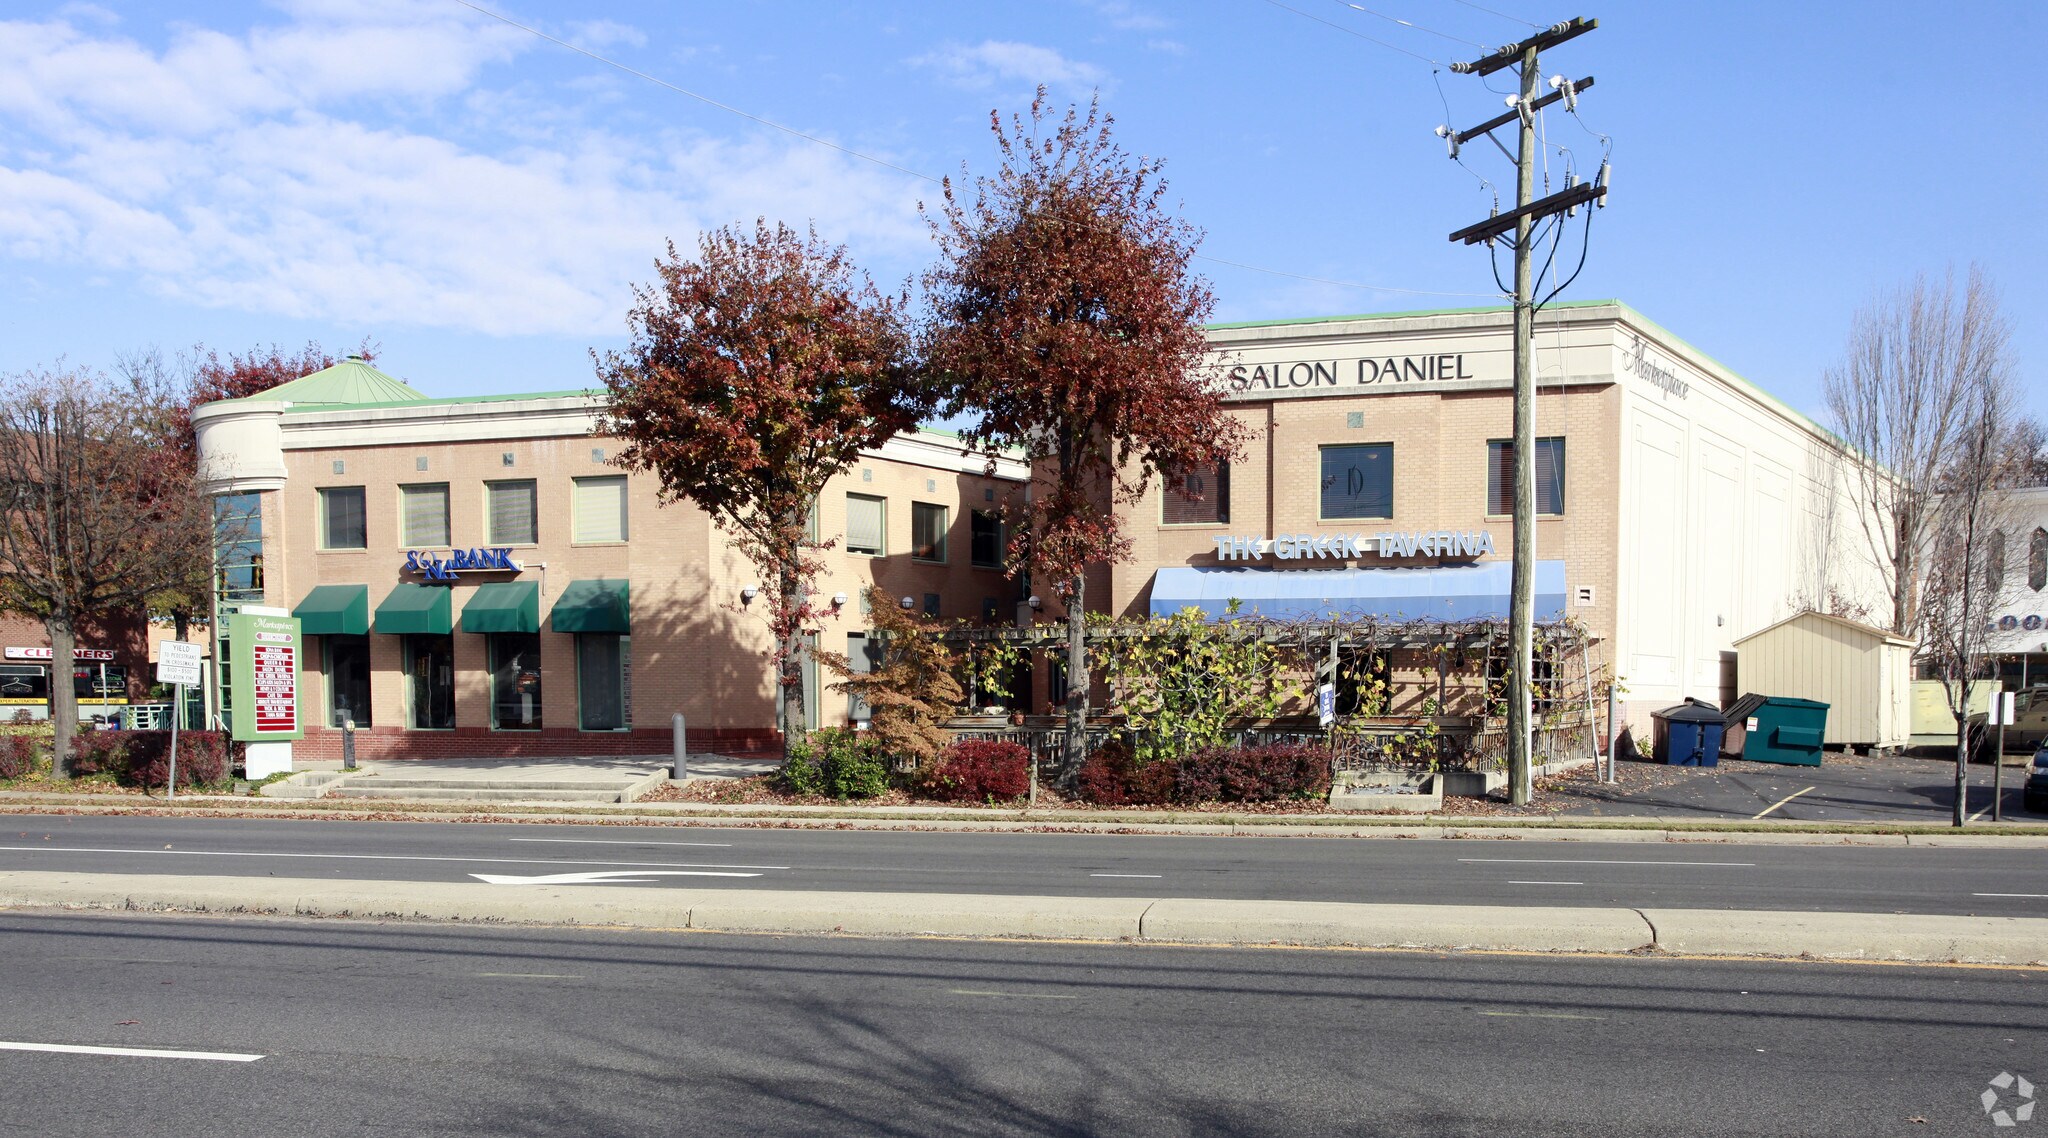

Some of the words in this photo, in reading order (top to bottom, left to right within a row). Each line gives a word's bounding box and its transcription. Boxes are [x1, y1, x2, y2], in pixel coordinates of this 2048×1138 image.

[1230, 360, 1338, 391] SALON
[1358, 354, 1473, 385] DANIEL
[1622, 335, 1689, 400] Marketplace
[1212, 534, 1263, 561] THE
[1273, 532, 1363, 561] GREEK
[1374, 529, 1496, 559] TAVERNA
[24, 648, 114, 659] CLENERS
[173, 644, 191, 653] YIELD
